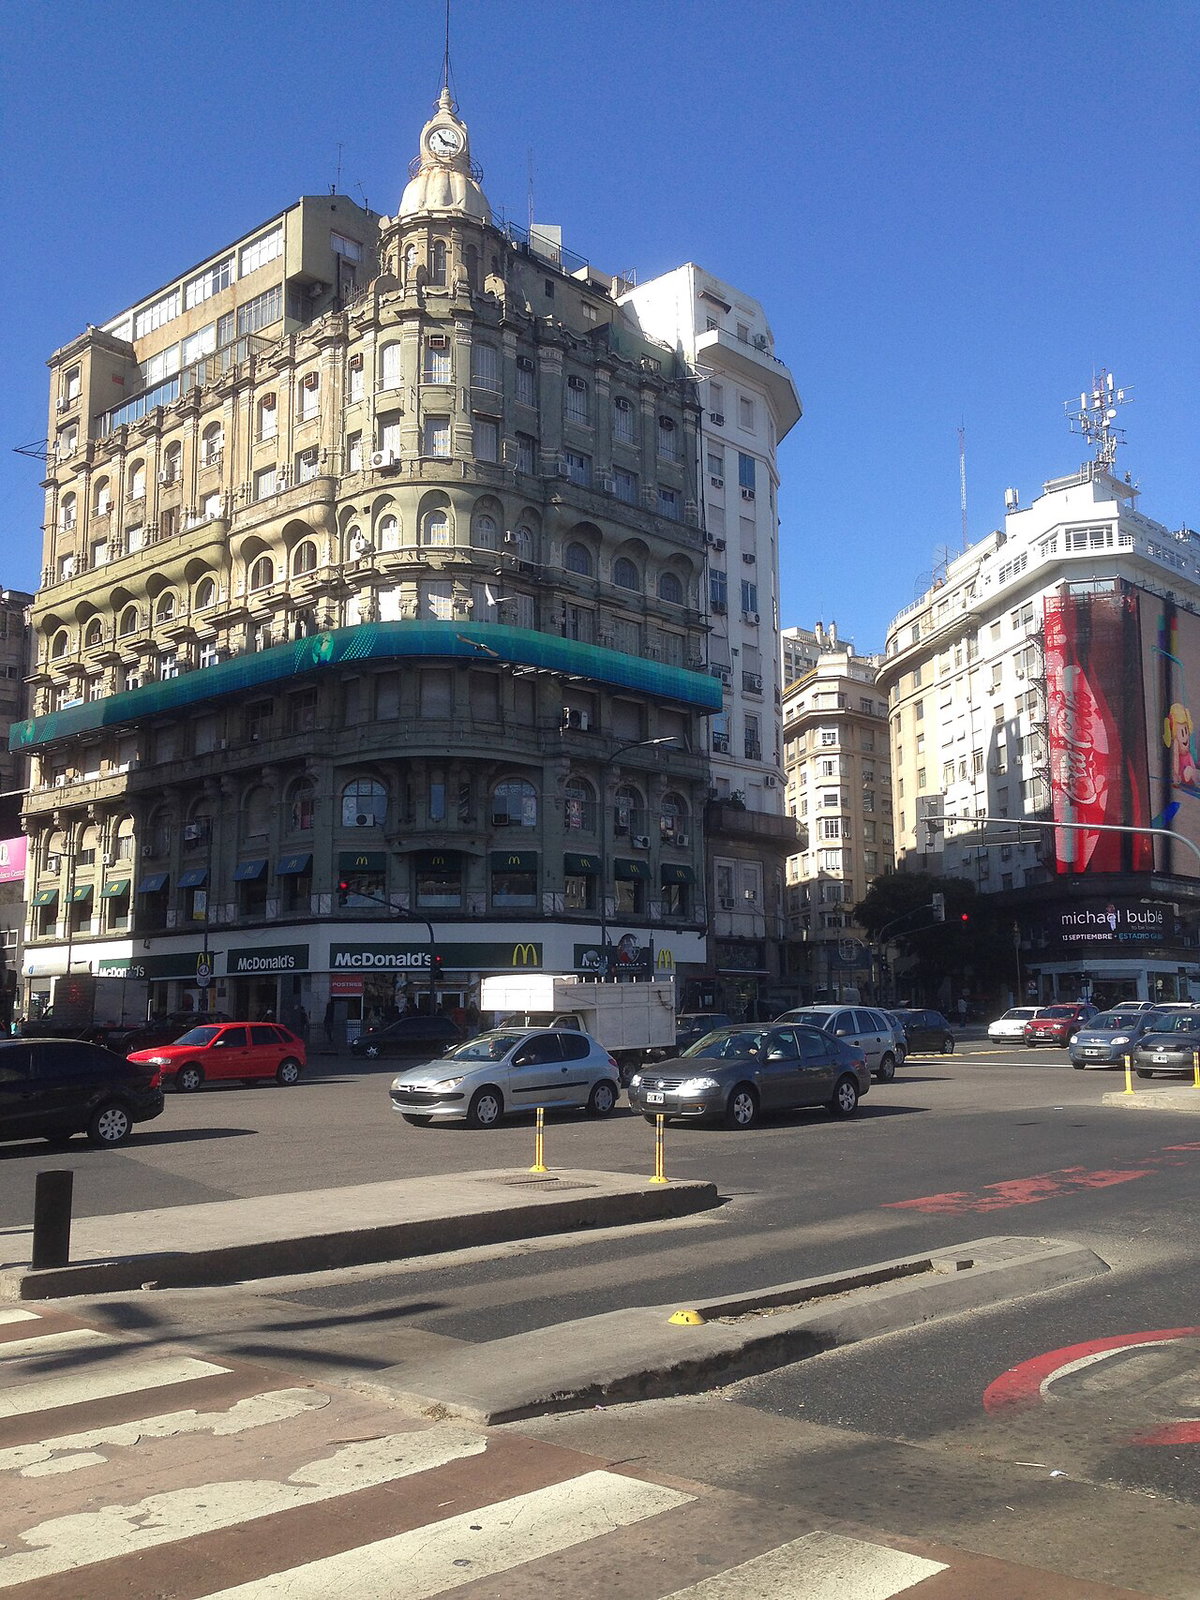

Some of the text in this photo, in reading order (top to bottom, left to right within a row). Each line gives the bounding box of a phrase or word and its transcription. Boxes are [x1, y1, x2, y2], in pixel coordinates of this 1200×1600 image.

[1061, 910, 1121, 925] michael
[1068, 933, 1113, 941] SEPTIEMBRE
[237, 955, 295, 971] McDonald's
[335, 952, 431, 966] McDonald's
